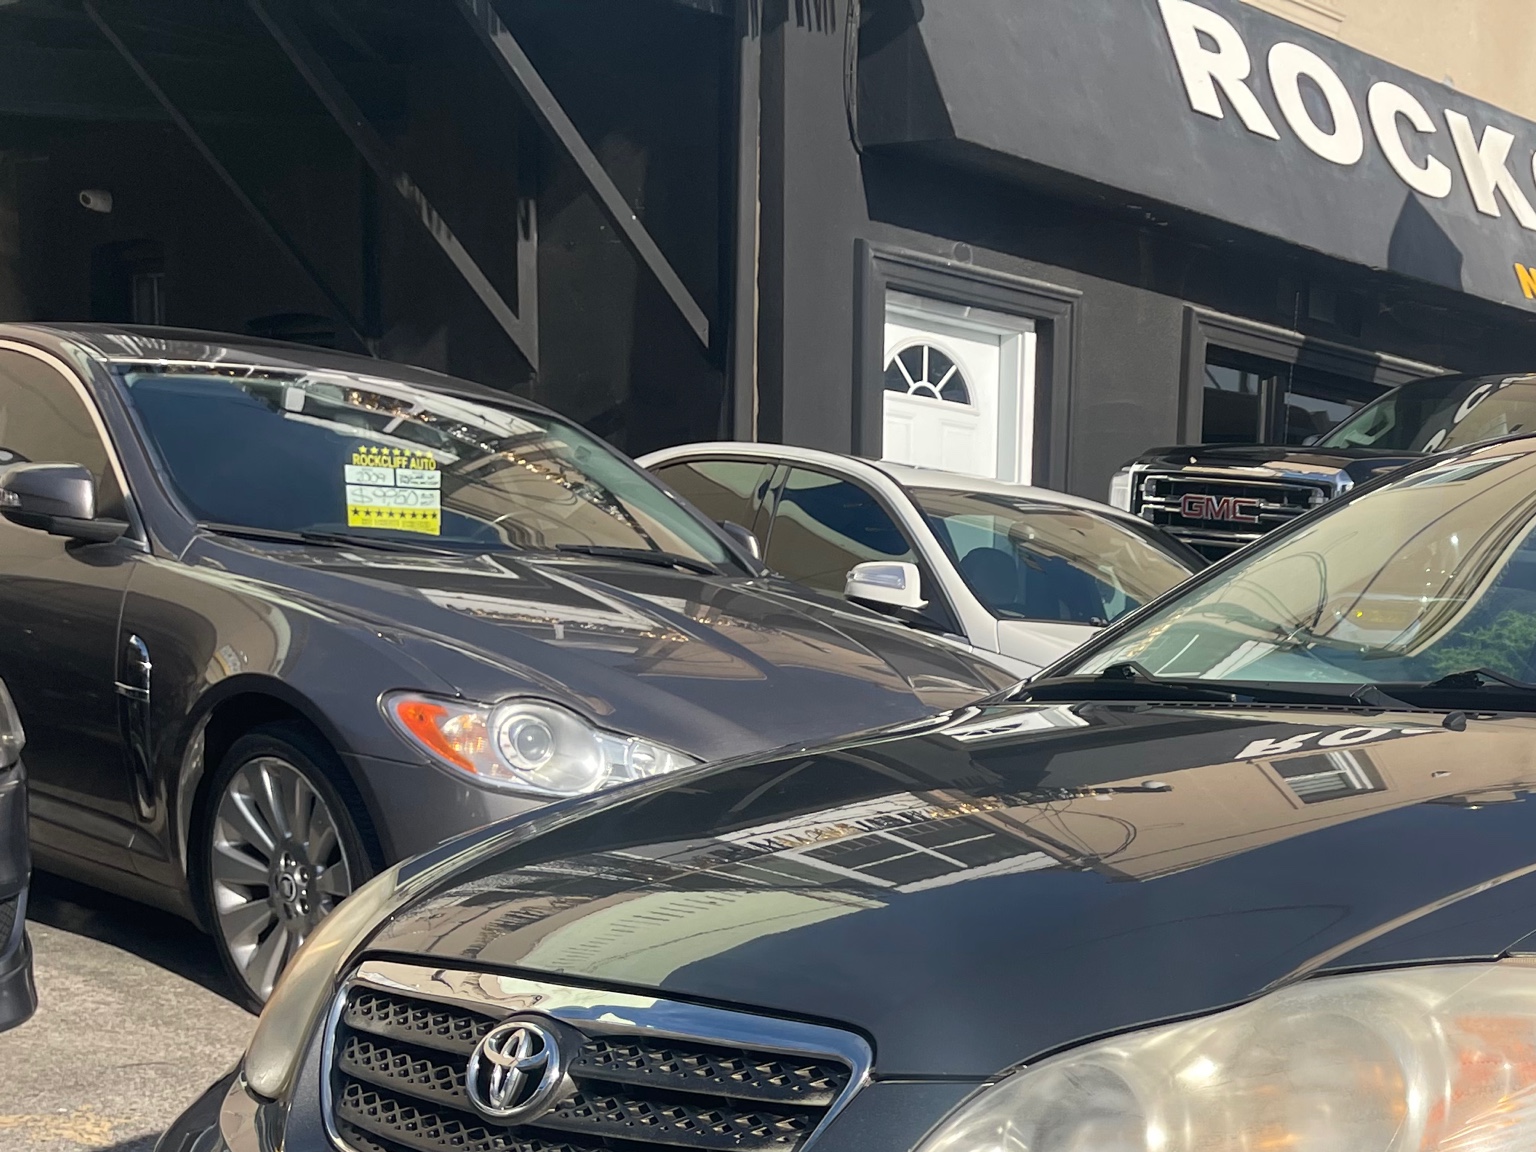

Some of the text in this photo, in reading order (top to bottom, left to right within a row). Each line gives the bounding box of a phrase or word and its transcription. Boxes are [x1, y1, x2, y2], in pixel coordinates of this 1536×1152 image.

[352, 453, 437, 471] ROCKCLIFF AUTO
[1181, 493, 1260, 524] GMC
